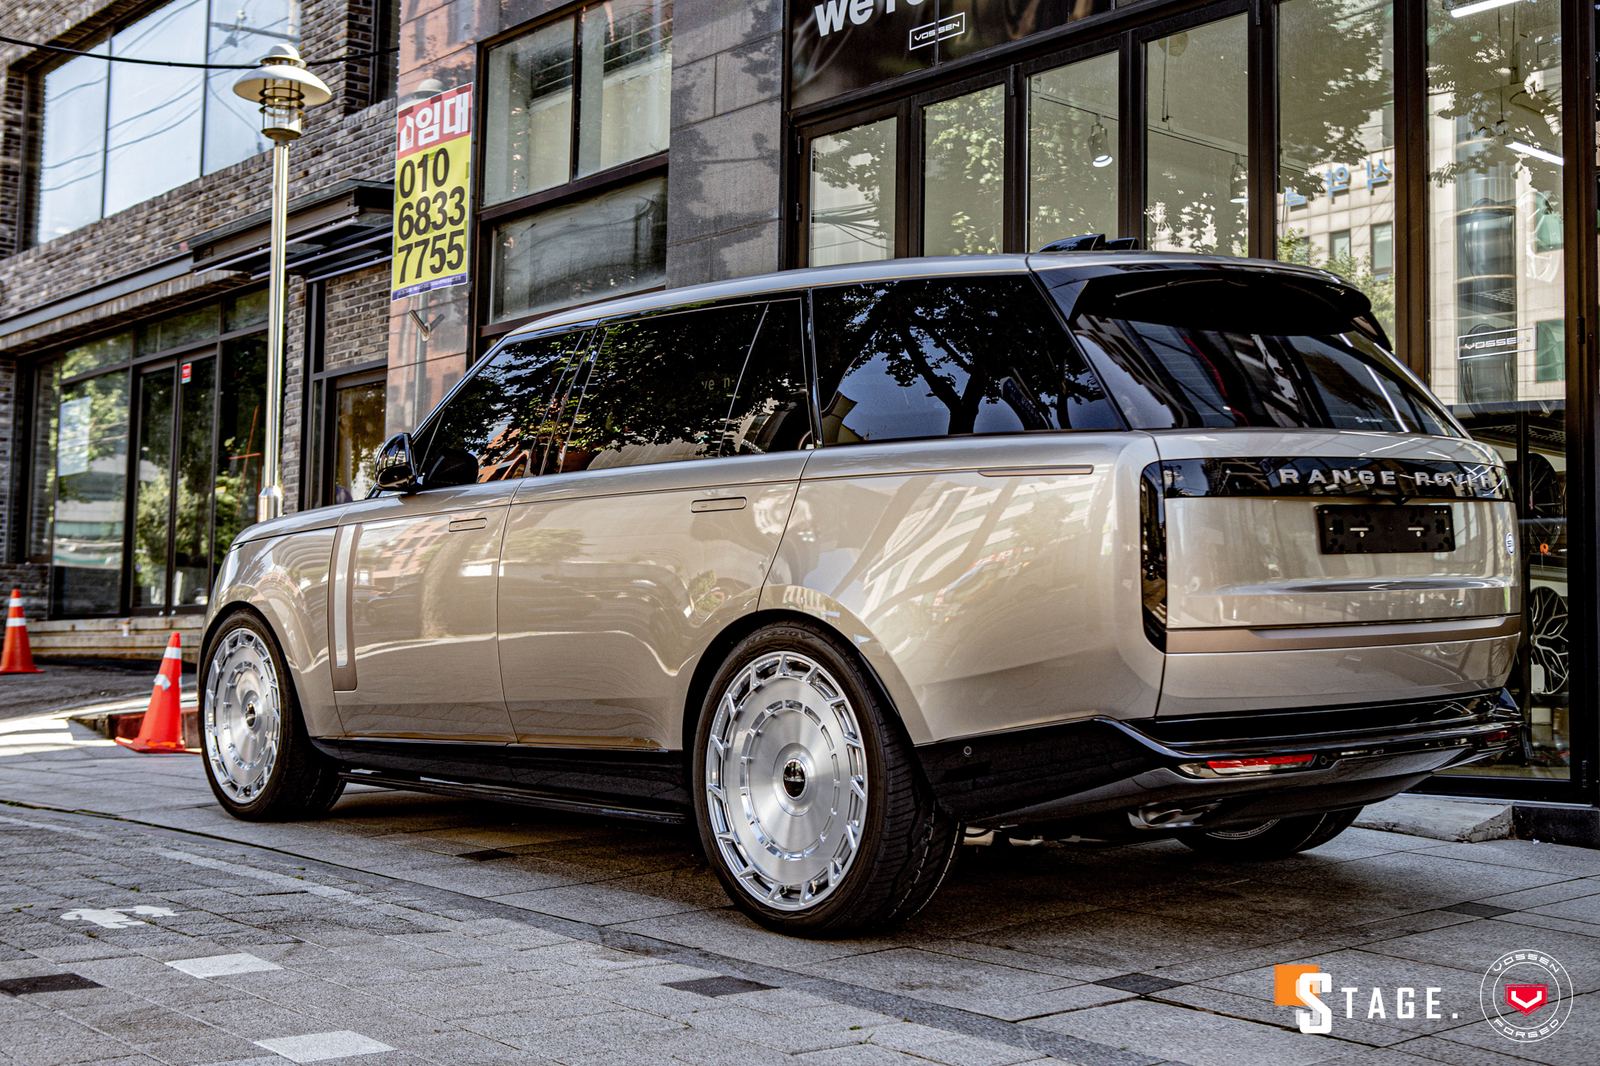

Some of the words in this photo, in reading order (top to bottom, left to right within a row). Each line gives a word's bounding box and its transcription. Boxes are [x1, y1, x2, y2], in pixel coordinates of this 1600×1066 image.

[914, 21, 960, 41] VOSSEN
[399, 148, 450, 199] 010
[398, 186, 465, 240] 6833
[398, 229, 464, 284] 7755
[1279, 468, 1396, 485] RANGE
[1414, 471, 1495, 489] ROVER
